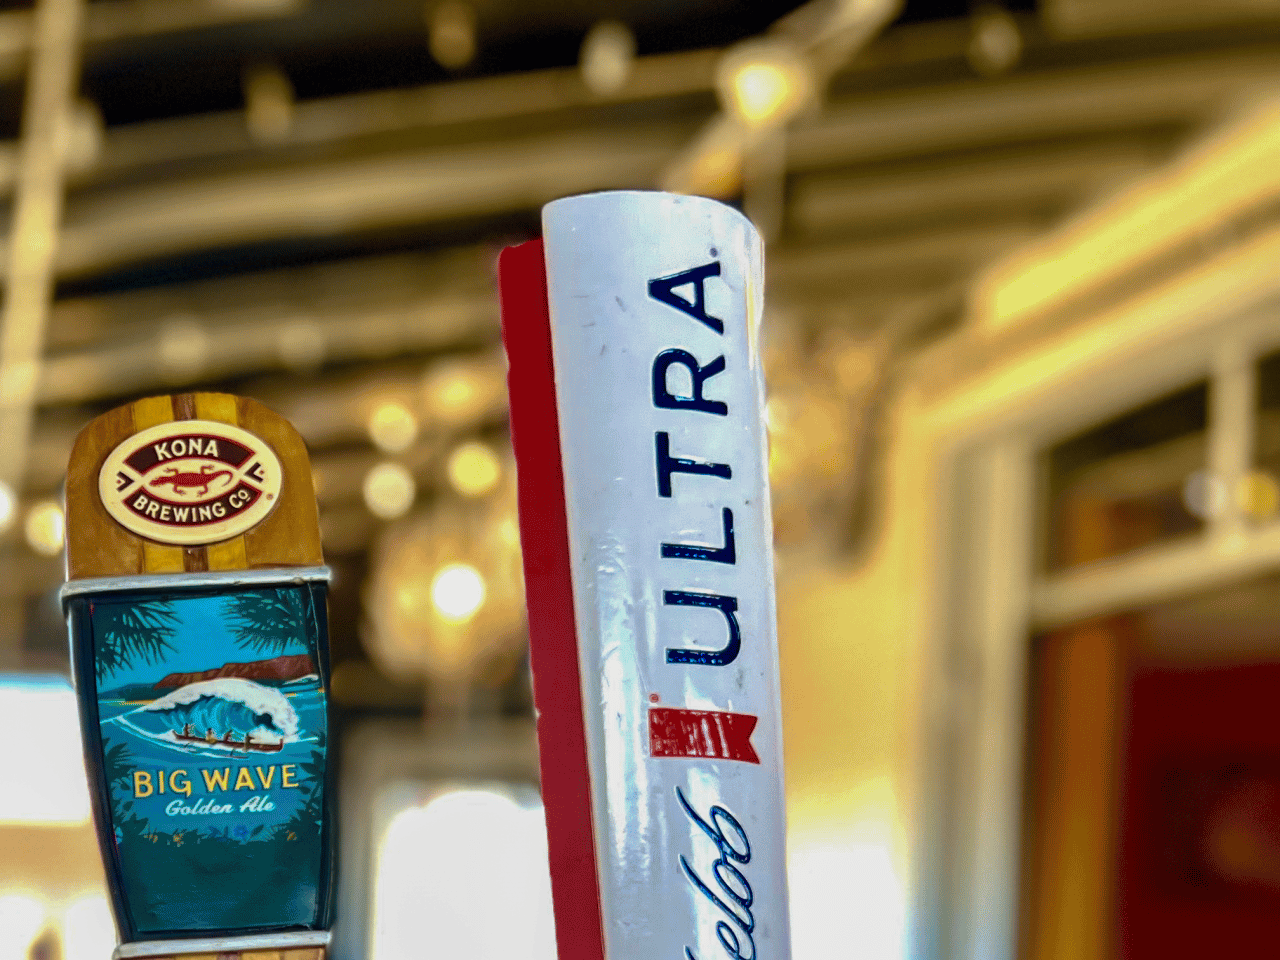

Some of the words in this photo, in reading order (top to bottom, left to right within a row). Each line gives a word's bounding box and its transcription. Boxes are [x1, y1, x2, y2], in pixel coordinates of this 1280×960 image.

[154, 438, 219, 461] KONA
[648, 261, 742, 667] ULTRA
[133, 495, 226, 523] BREWING
[133, 769, 192, 798] BIG
[201, 764, 299, 793] WAVE
[165, 799, 234, 816] Golden
[239, 796, 275, 812] Ale
